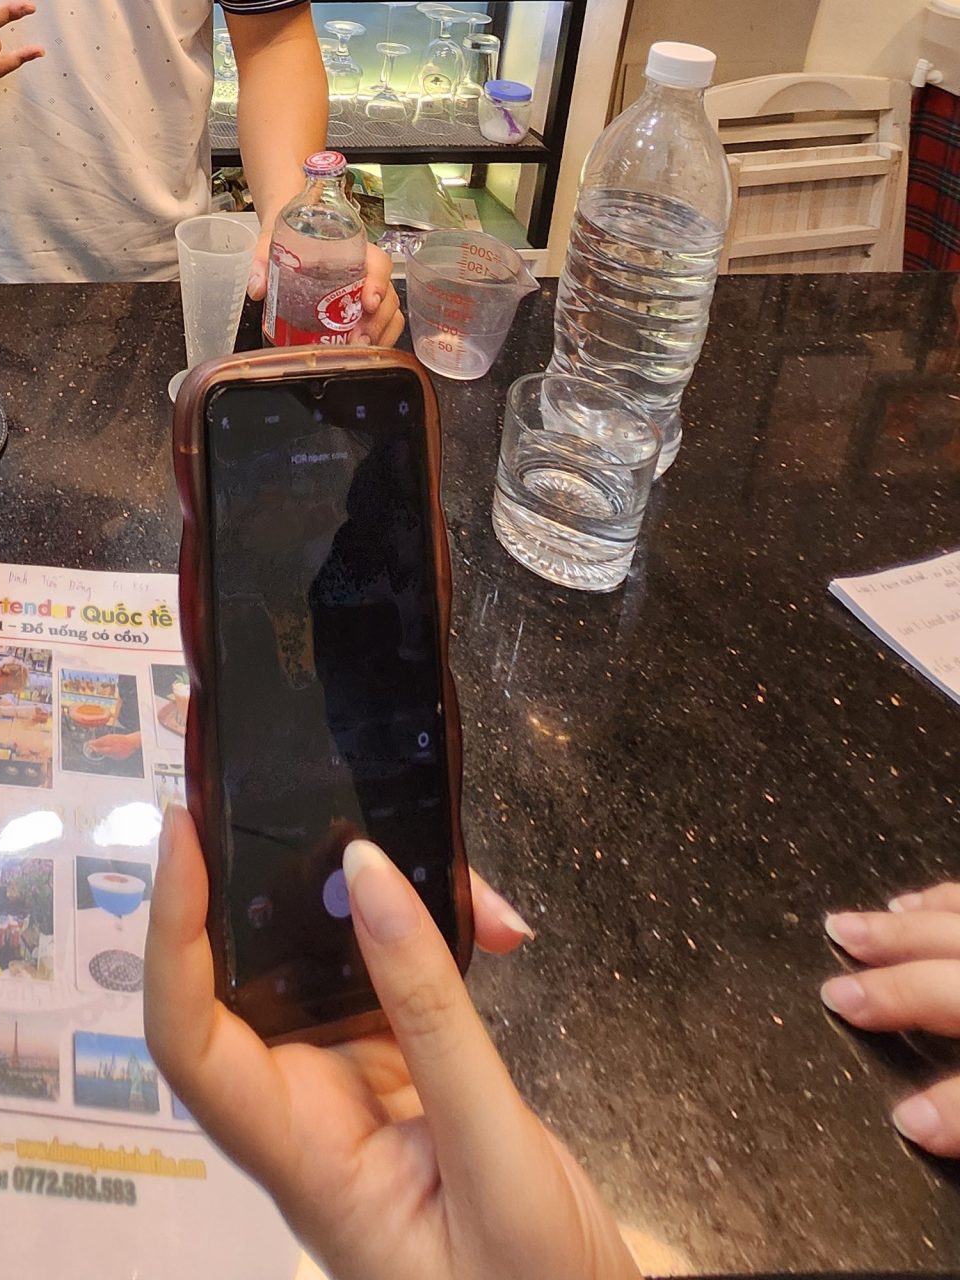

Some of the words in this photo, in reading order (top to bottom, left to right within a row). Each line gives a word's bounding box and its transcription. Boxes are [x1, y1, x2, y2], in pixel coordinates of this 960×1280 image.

[325, 288, 347, 303] SODA
[320, 334, 348, 345] SIN
[438, 340, 453, 353] 50
[82, 602, 144, 627] Quốc
[48, 624, 88, 642] uống
[91, 629, 110, 641] có
[114, 628, 150, 645] cồn)
